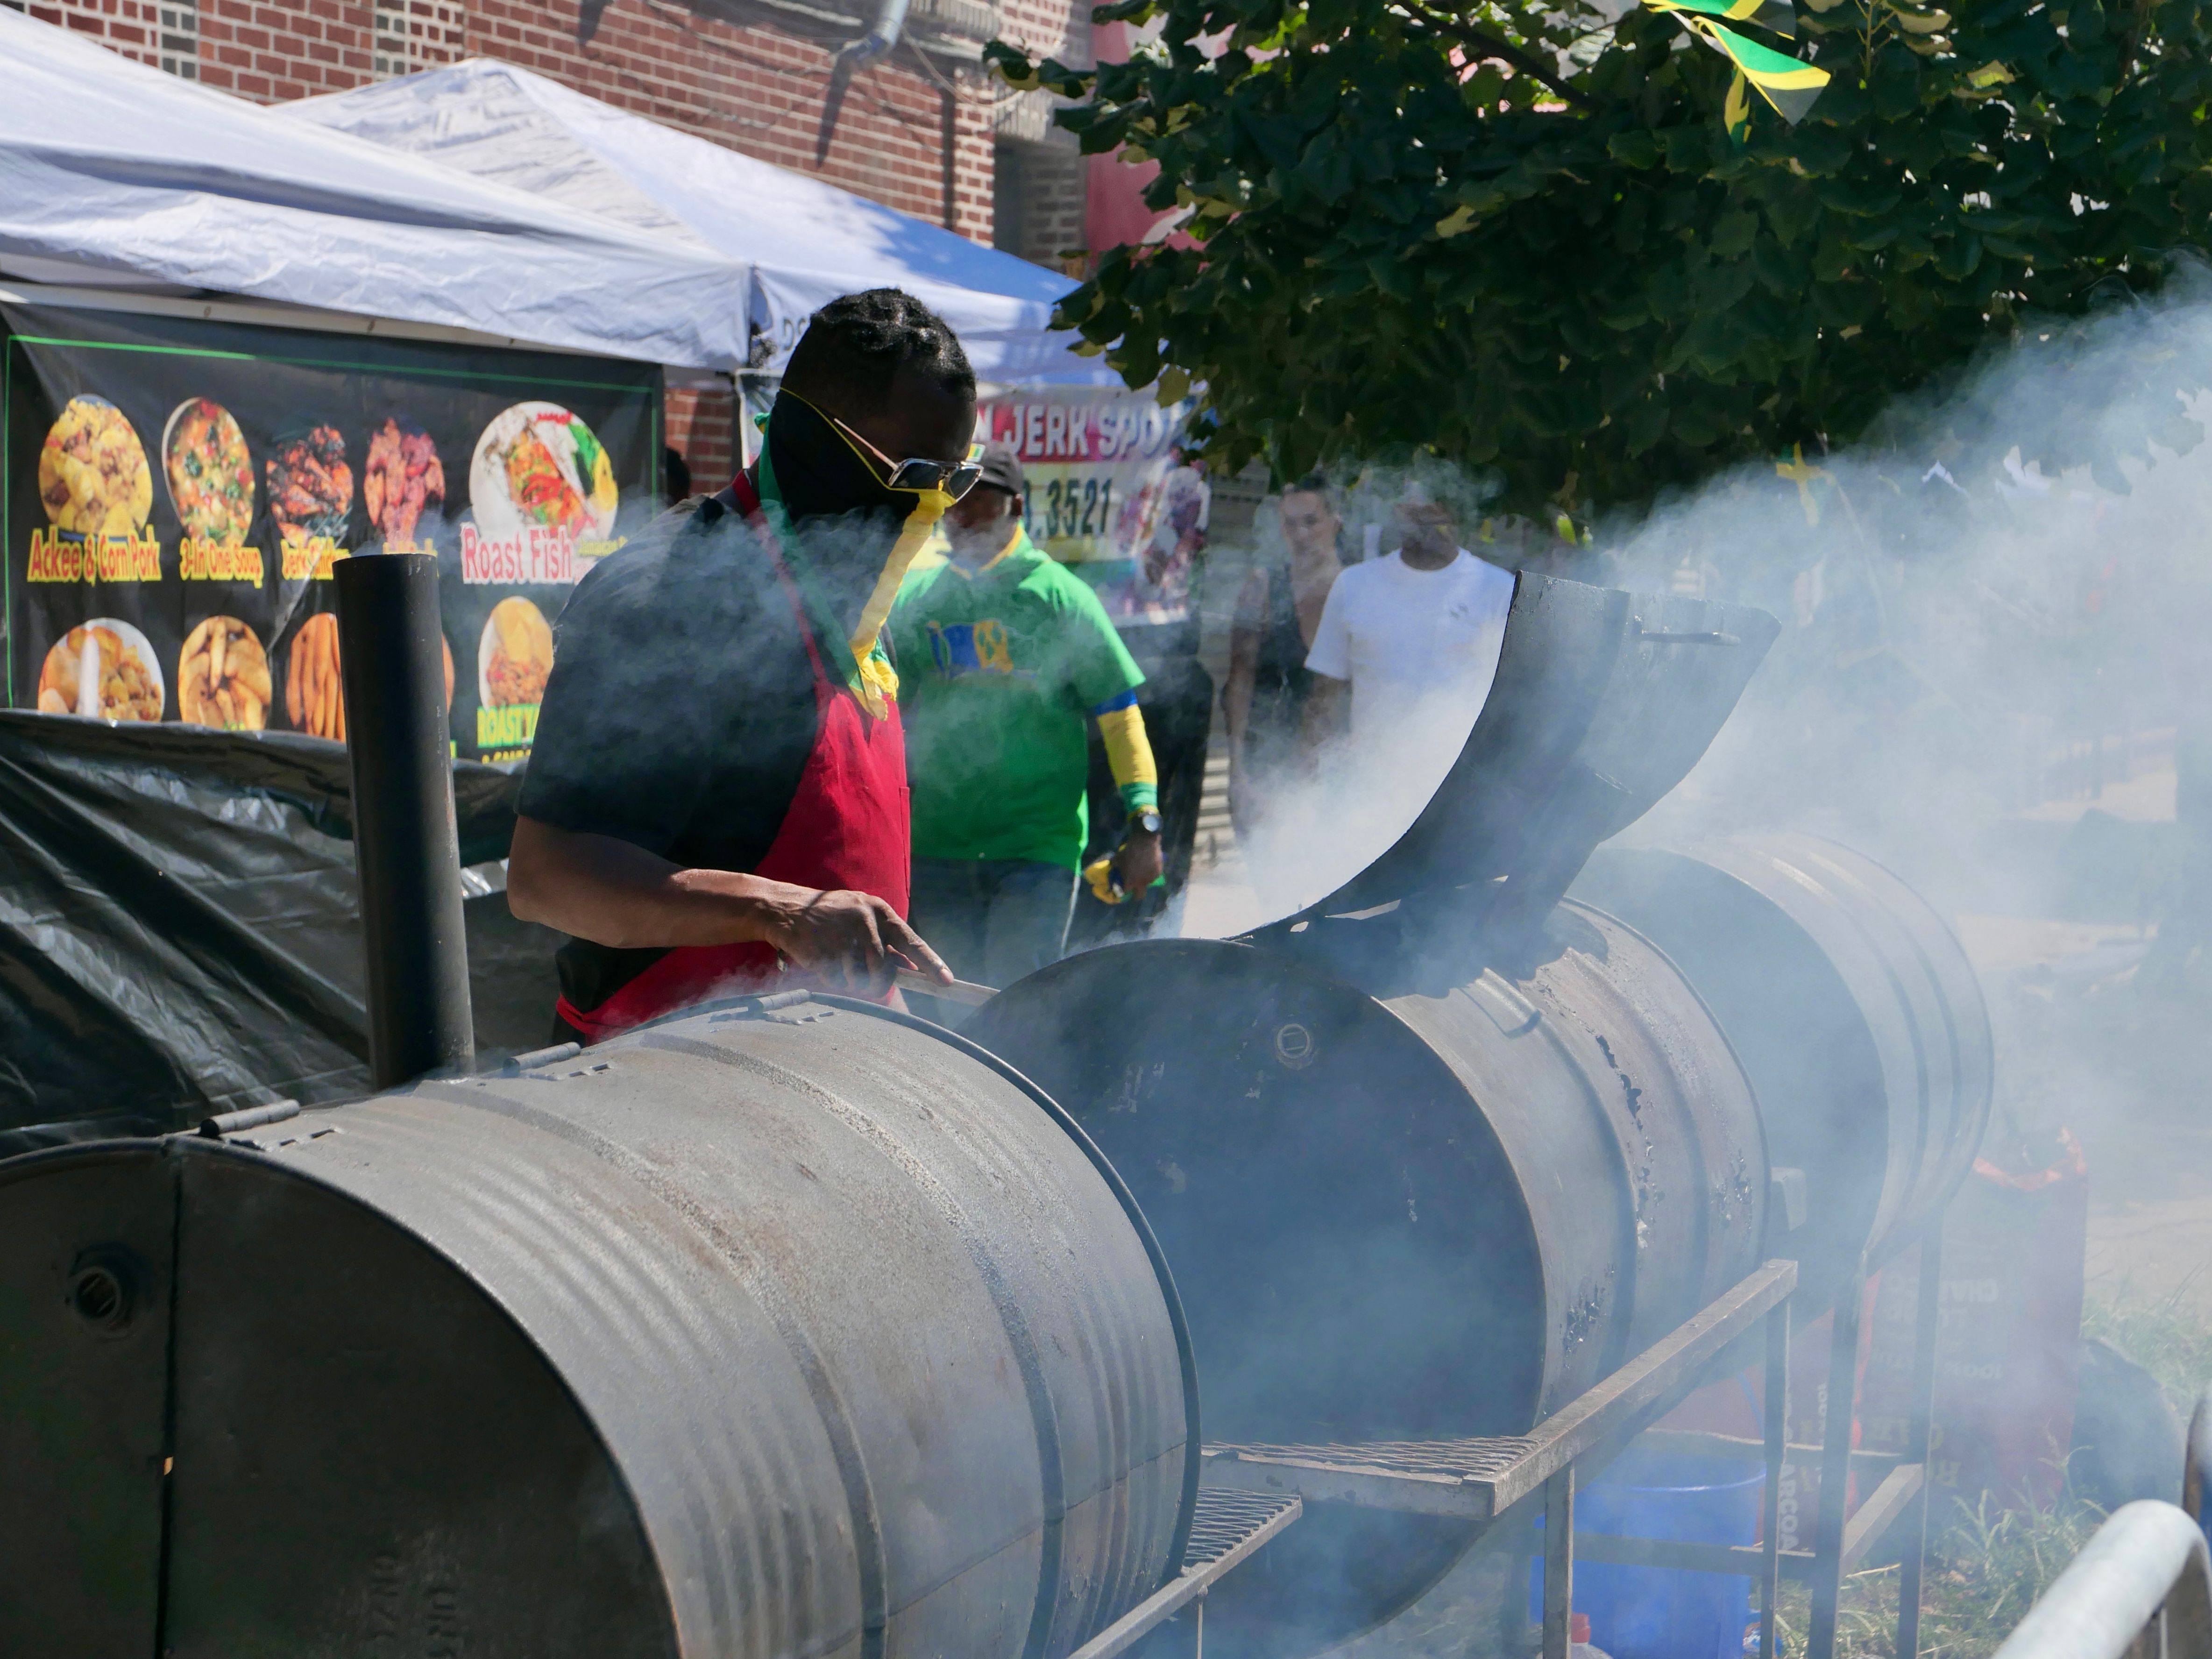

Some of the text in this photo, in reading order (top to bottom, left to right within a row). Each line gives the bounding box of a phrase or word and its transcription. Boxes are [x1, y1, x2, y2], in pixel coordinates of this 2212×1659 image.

[1003, 403, 1088, 456] JERK
[27, 524, 82, 582] Ackee
[84, 532, 97, 587] &
[128, 524, 162, 582] Pork
[207, 537, 234, 581] One
[233, 539, 263, 589] Soup
[461, 523, 573, 583] Roast Fish
[476, 704, 522, 747] ROAST
